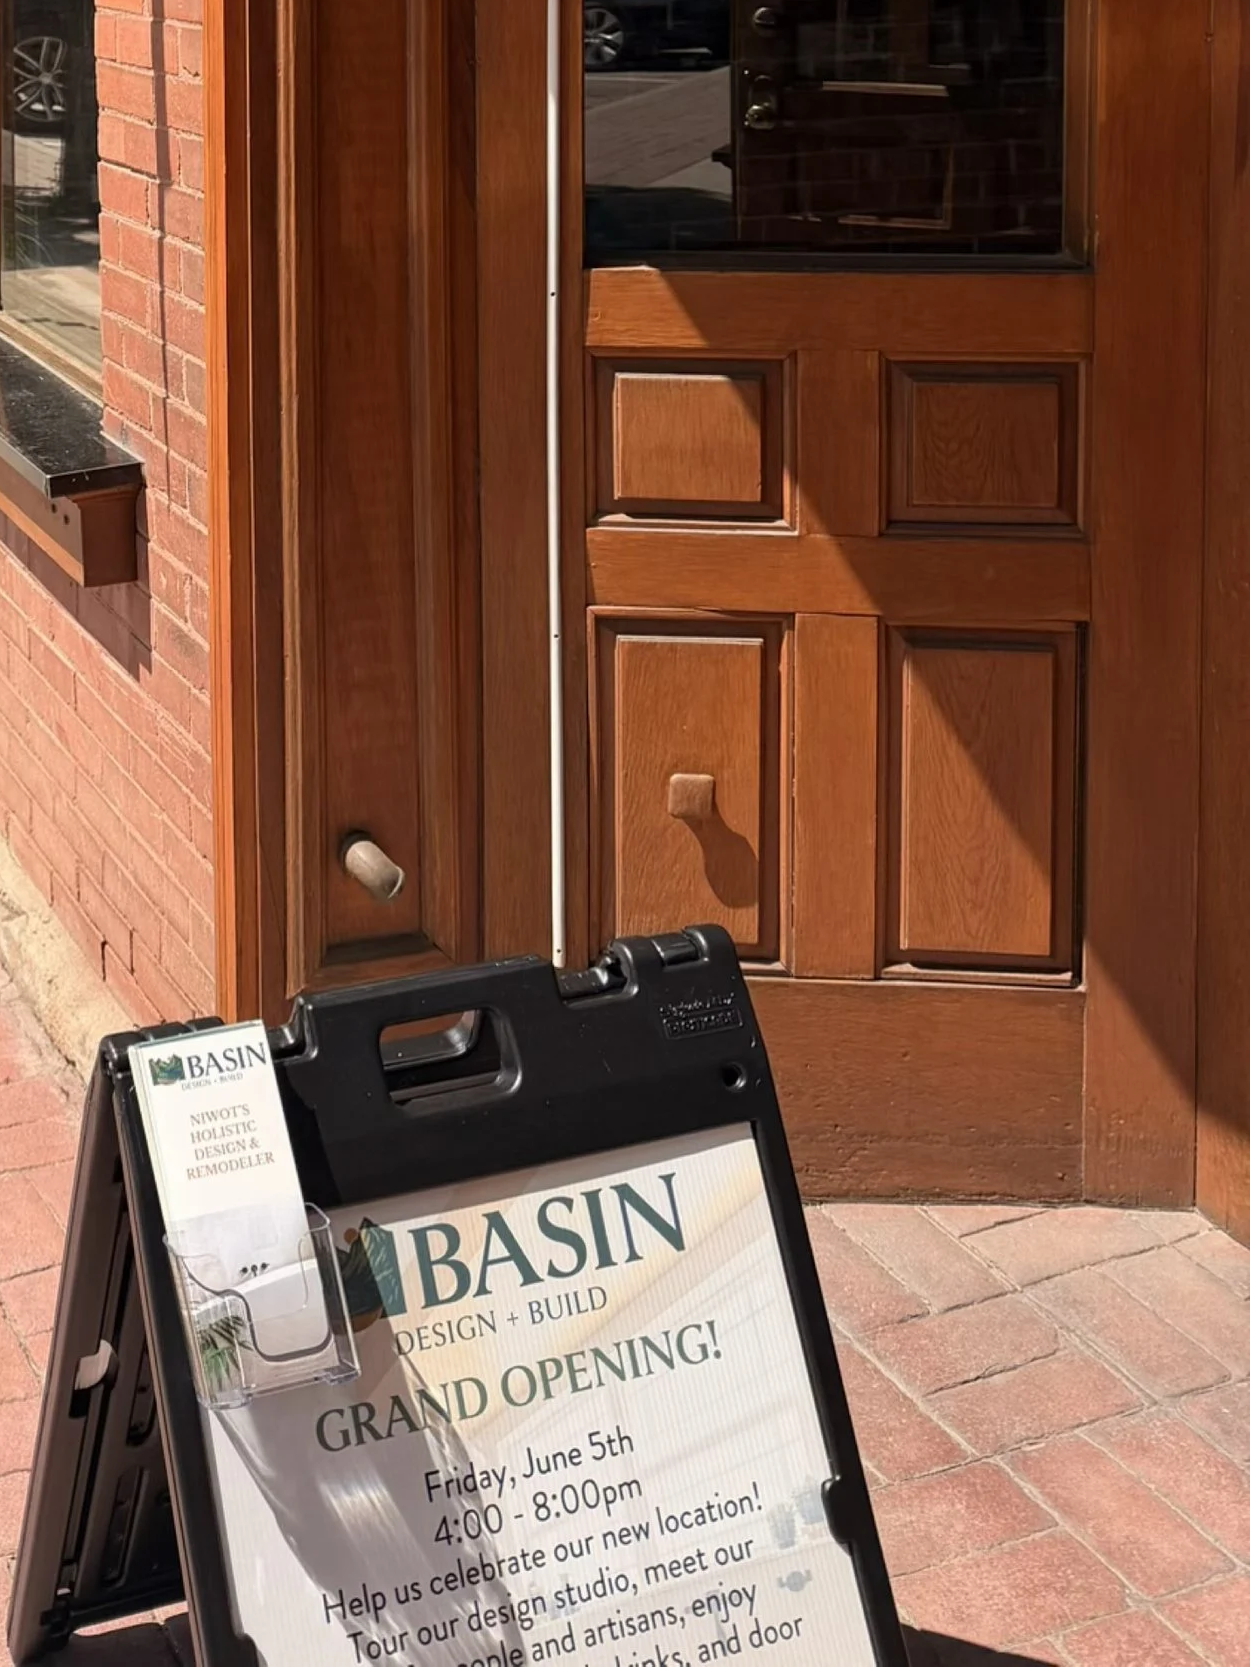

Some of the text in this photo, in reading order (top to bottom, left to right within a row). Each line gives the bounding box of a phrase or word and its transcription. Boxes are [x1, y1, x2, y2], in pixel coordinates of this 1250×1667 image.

[187, 1042, 267, 1079] BASIN
[190, 1103, 251, 1126] NIWOT'S
[190, 1120, 257, 1144] HOLISTIC
[194, 1137, 261, 1161] DESIGN &
[186, 1151, 275, 1180] REMODELER
[408, 1172, 687, 1310] BASIN
[394, 1310, 497, 1357] DESIGN
[529, 1285, 608, 1326] BUILD
[315, 1320, 722, 1453] GRAND OPENING!
[424, 1425, 635, 1503] Friday, June 5th
[434, 1504, 503, 1546] 4:00
[532, 1478, 643, 1522] 8:00pm
[322, 1482, 763, 1624] Help us celebrate our new location!
[347, 1539, 754, 1664] Tour our design studio, meet our
[532, 1621, 576, 1662] and
[584, 1605, 686, 1648] artisans,
[691, 1581, 756, 1624] enjoy
[699, 1623, 742, 1664] and
[749, 1617, 803, 1650] door
